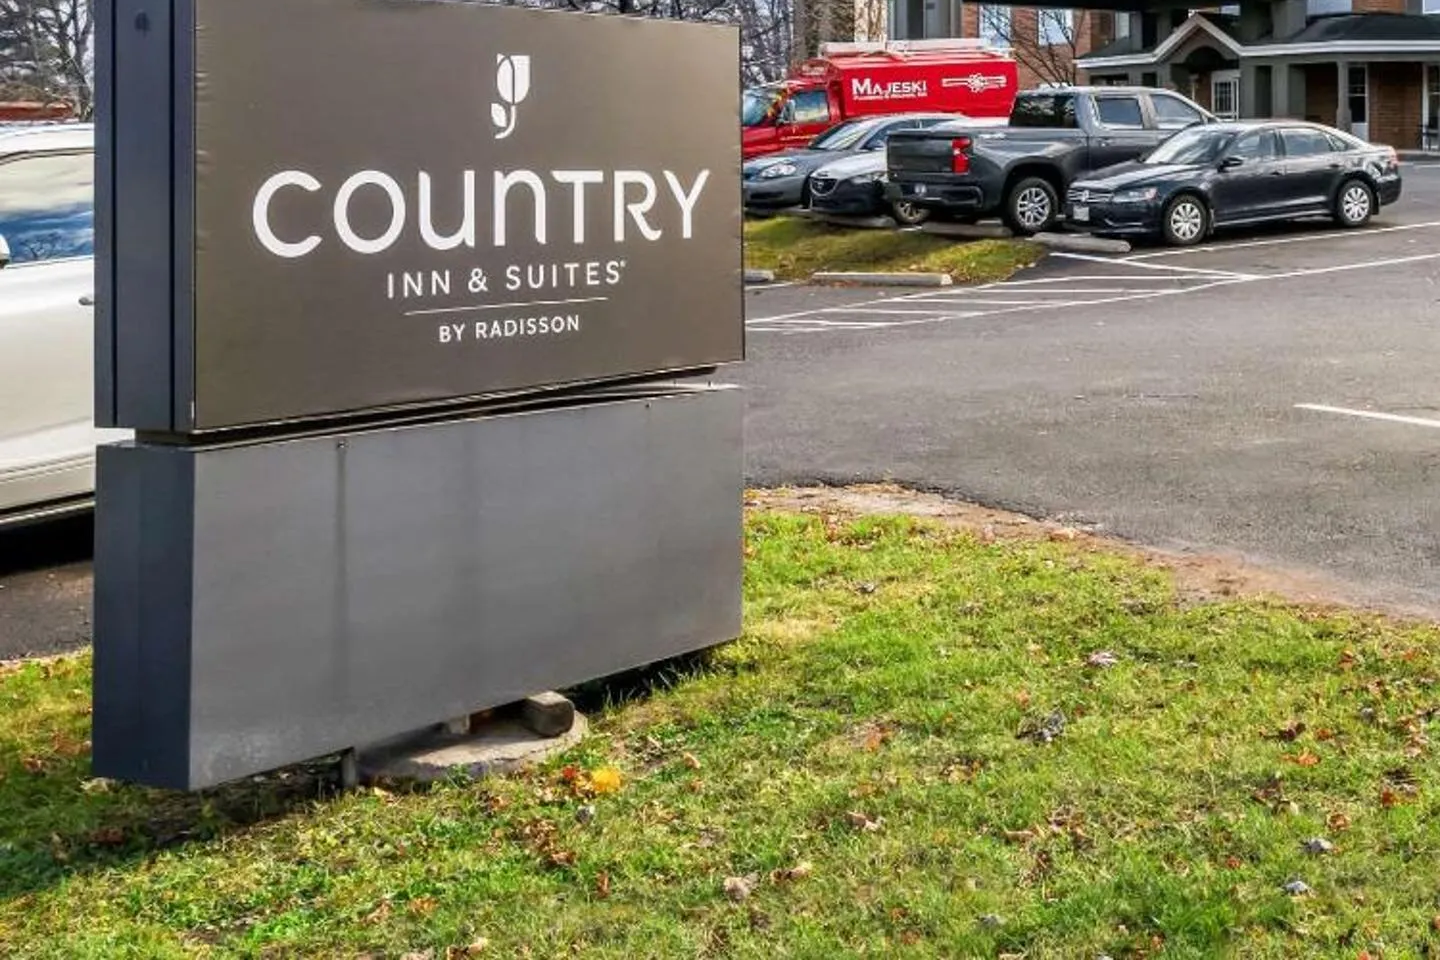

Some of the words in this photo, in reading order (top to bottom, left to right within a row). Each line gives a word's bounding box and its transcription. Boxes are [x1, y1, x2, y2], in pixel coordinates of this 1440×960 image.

[252, 168, 710, 258] COUNTRY
[387, 270, 450, 299] INN
[467, 267, 489, 293] &
[438, 324, 465, 343] BY
[475, 315, 580, 339] RADISSON
